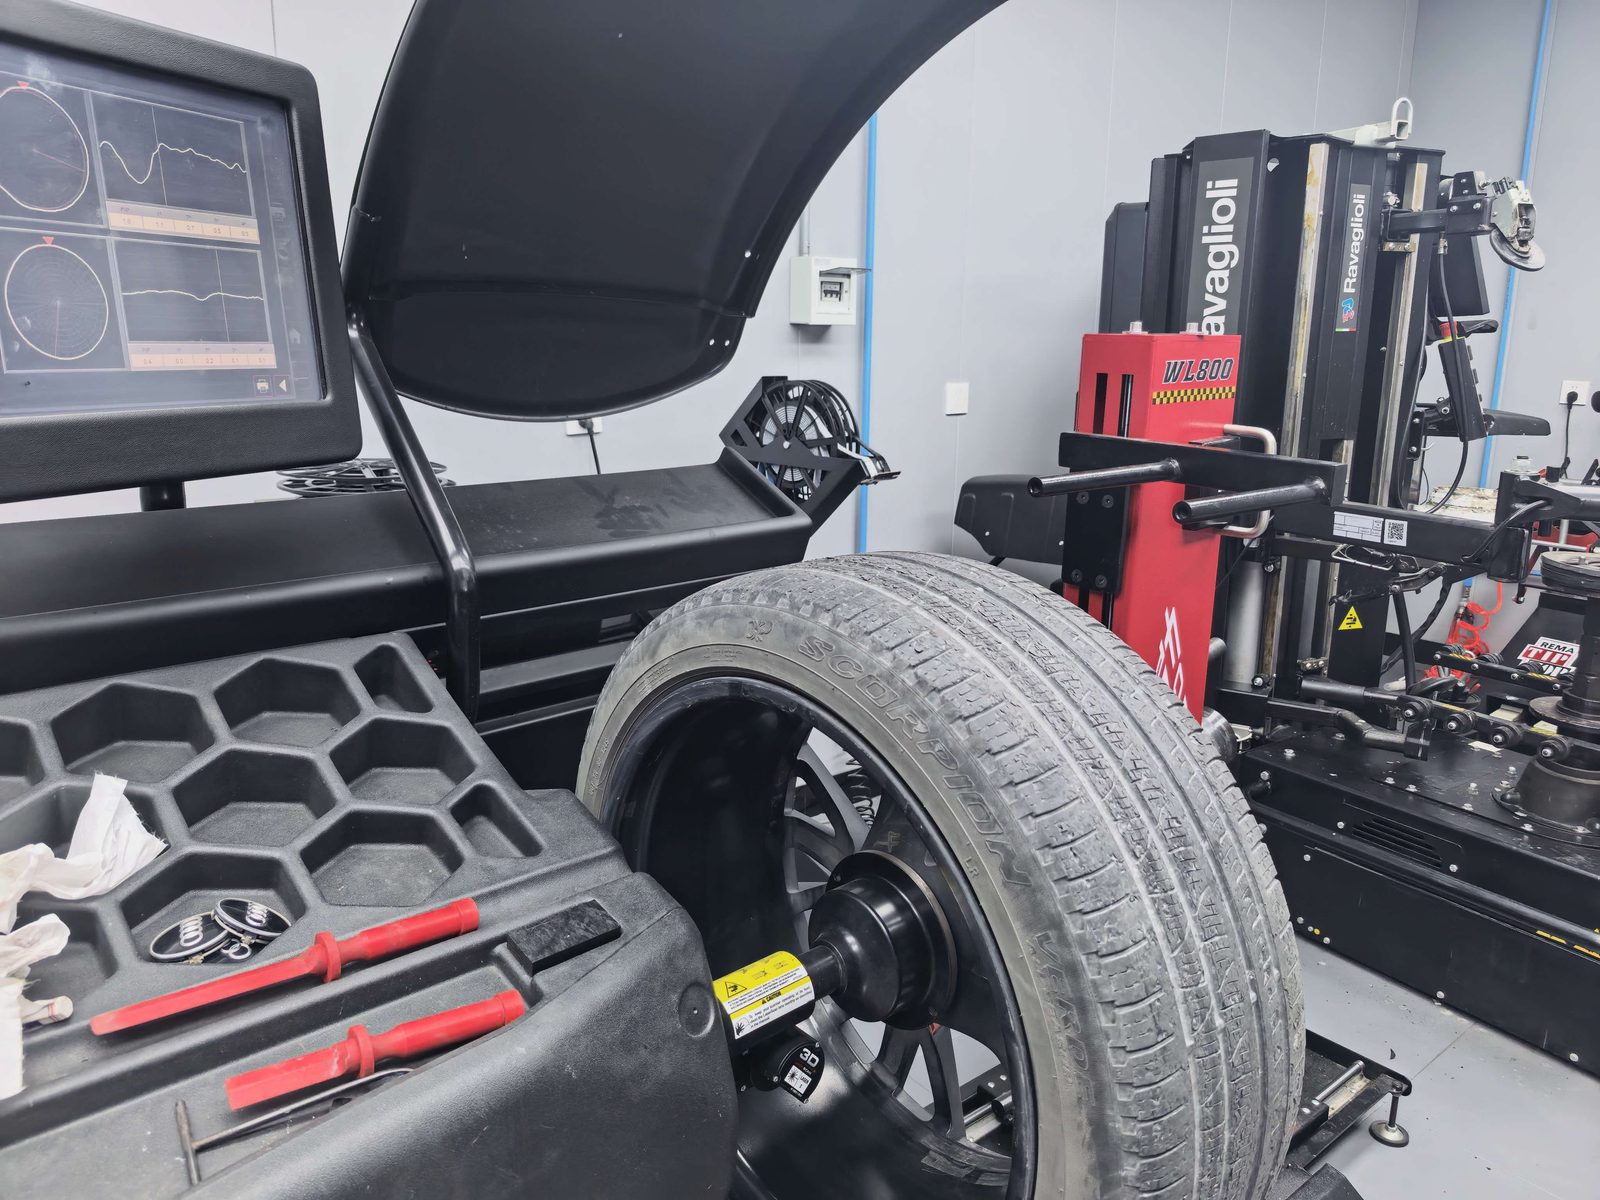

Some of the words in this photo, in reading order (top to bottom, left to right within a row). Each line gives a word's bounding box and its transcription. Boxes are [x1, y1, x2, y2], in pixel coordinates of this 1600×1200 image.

[1343, 193, 1366, 293] Ravaglioli
[1201, 178, 1240, 336] avaglioli
[1162, 358, 1234, 384] WL800
[1526, 646, 1569, 663] TIP
[1541, 641, 1574, 653] REMA
[799, 635, 1033, 886] SCORPION
[965, 857, 980, 879] LR
[1034, 930, 1096, 1107] VERDE
[800, 1047, 820, 1068] 3D
